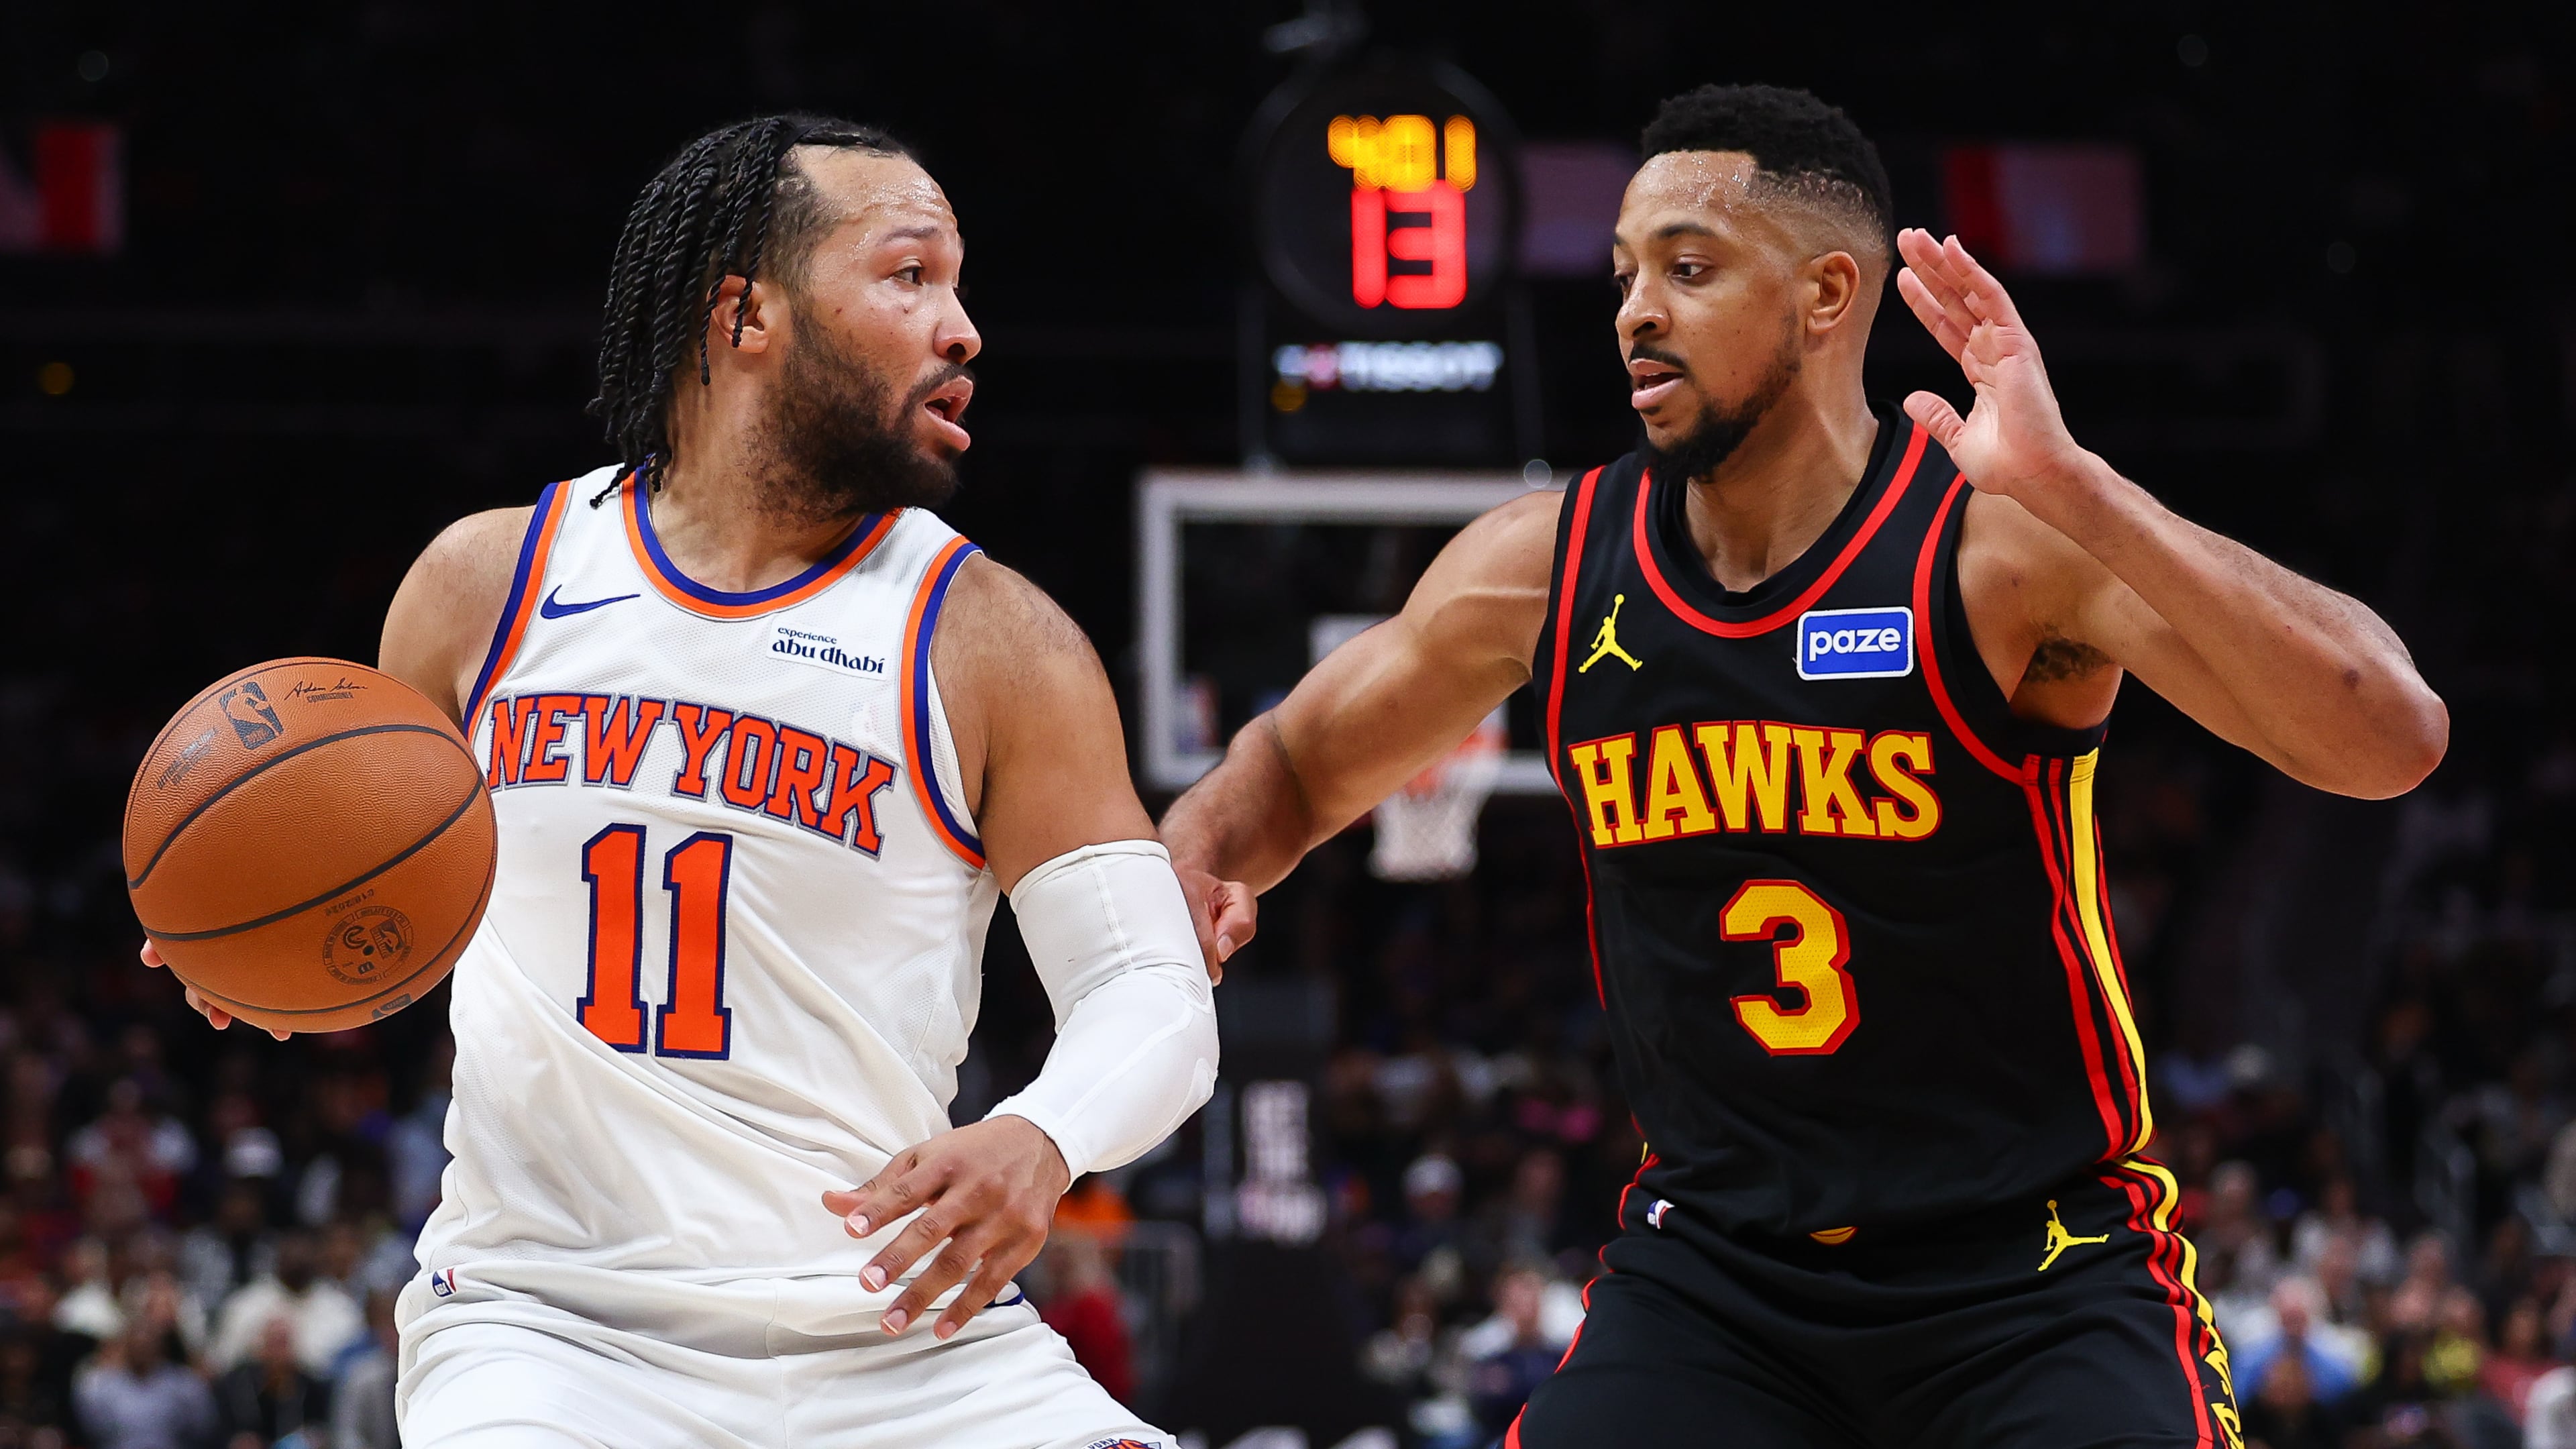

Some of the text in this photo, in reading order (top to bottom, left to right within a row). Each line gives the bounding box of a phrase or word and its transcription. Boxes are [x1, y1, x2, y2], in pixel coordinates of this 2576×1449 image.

[1351, 180, 1467, 309] 13
[771, 638, 885, 674] abu dhabi
[777, 627, 837, 644] experience
[1809, 627, 1901, 661] paze
[487, 691, 899, 861] NEW YORK
[1568, 720, 1942, 849] HAWKS
[576, 823, 733, 1061] 11
[1719, 879, 1860, 1057] 3
